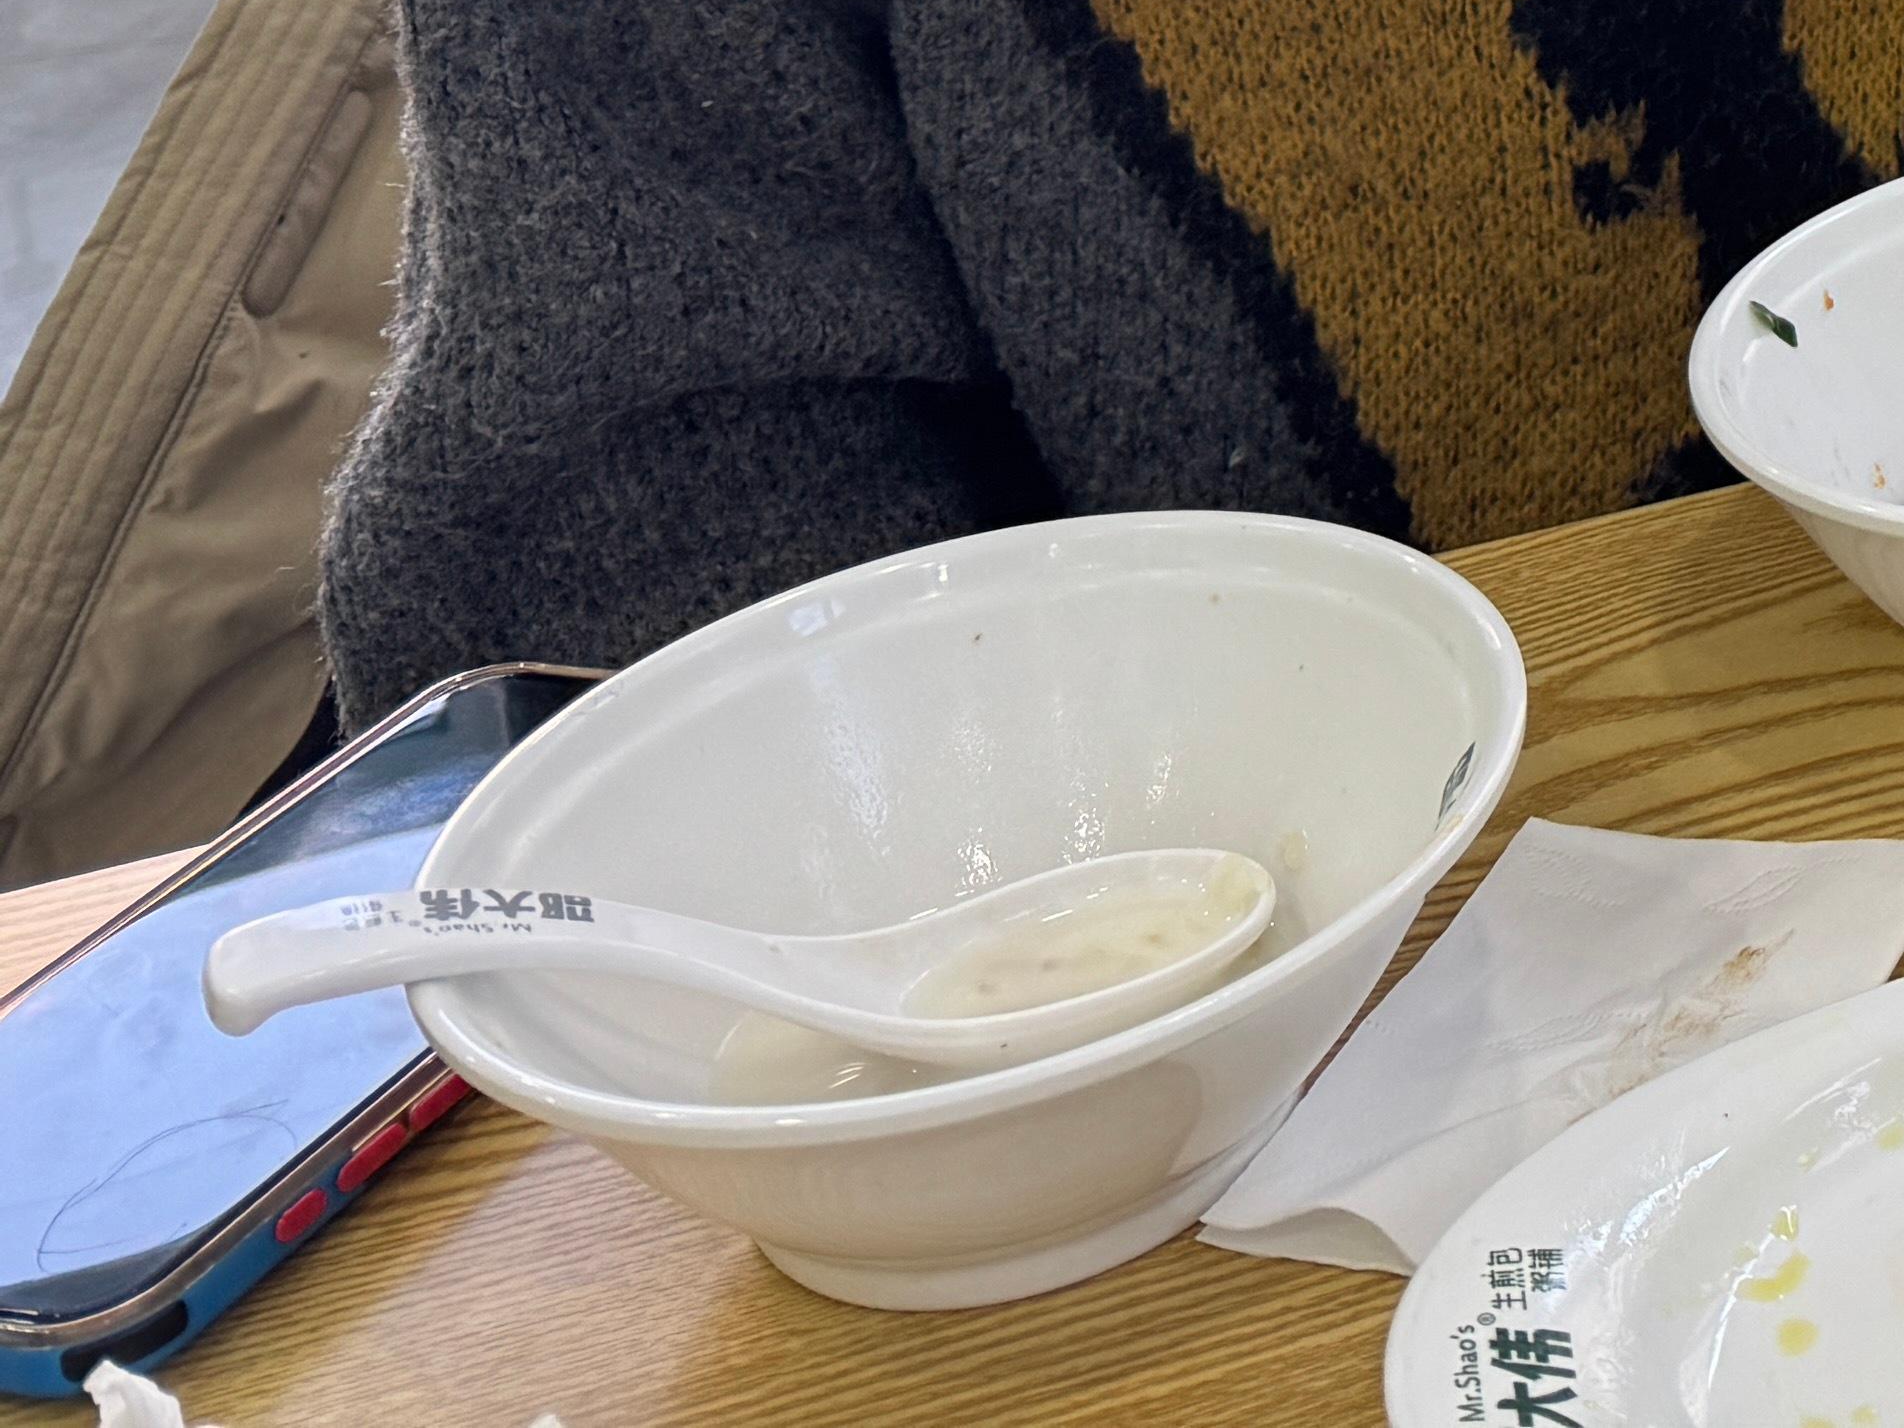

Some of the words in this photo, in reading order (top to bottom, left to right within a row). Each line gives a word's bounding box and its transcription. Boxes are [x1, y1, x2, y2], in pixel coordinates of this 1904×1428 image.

[419, 888, 595, 923] 邵大伟
[1480, 1247, 1528, 1311] 生煎包
[1526, 1249, 1568, 1293] 粥铺
[1449, 1324, 1486, 1423] Mr.Shao's
[1488, 1327, 1585, 1428] 大伟
